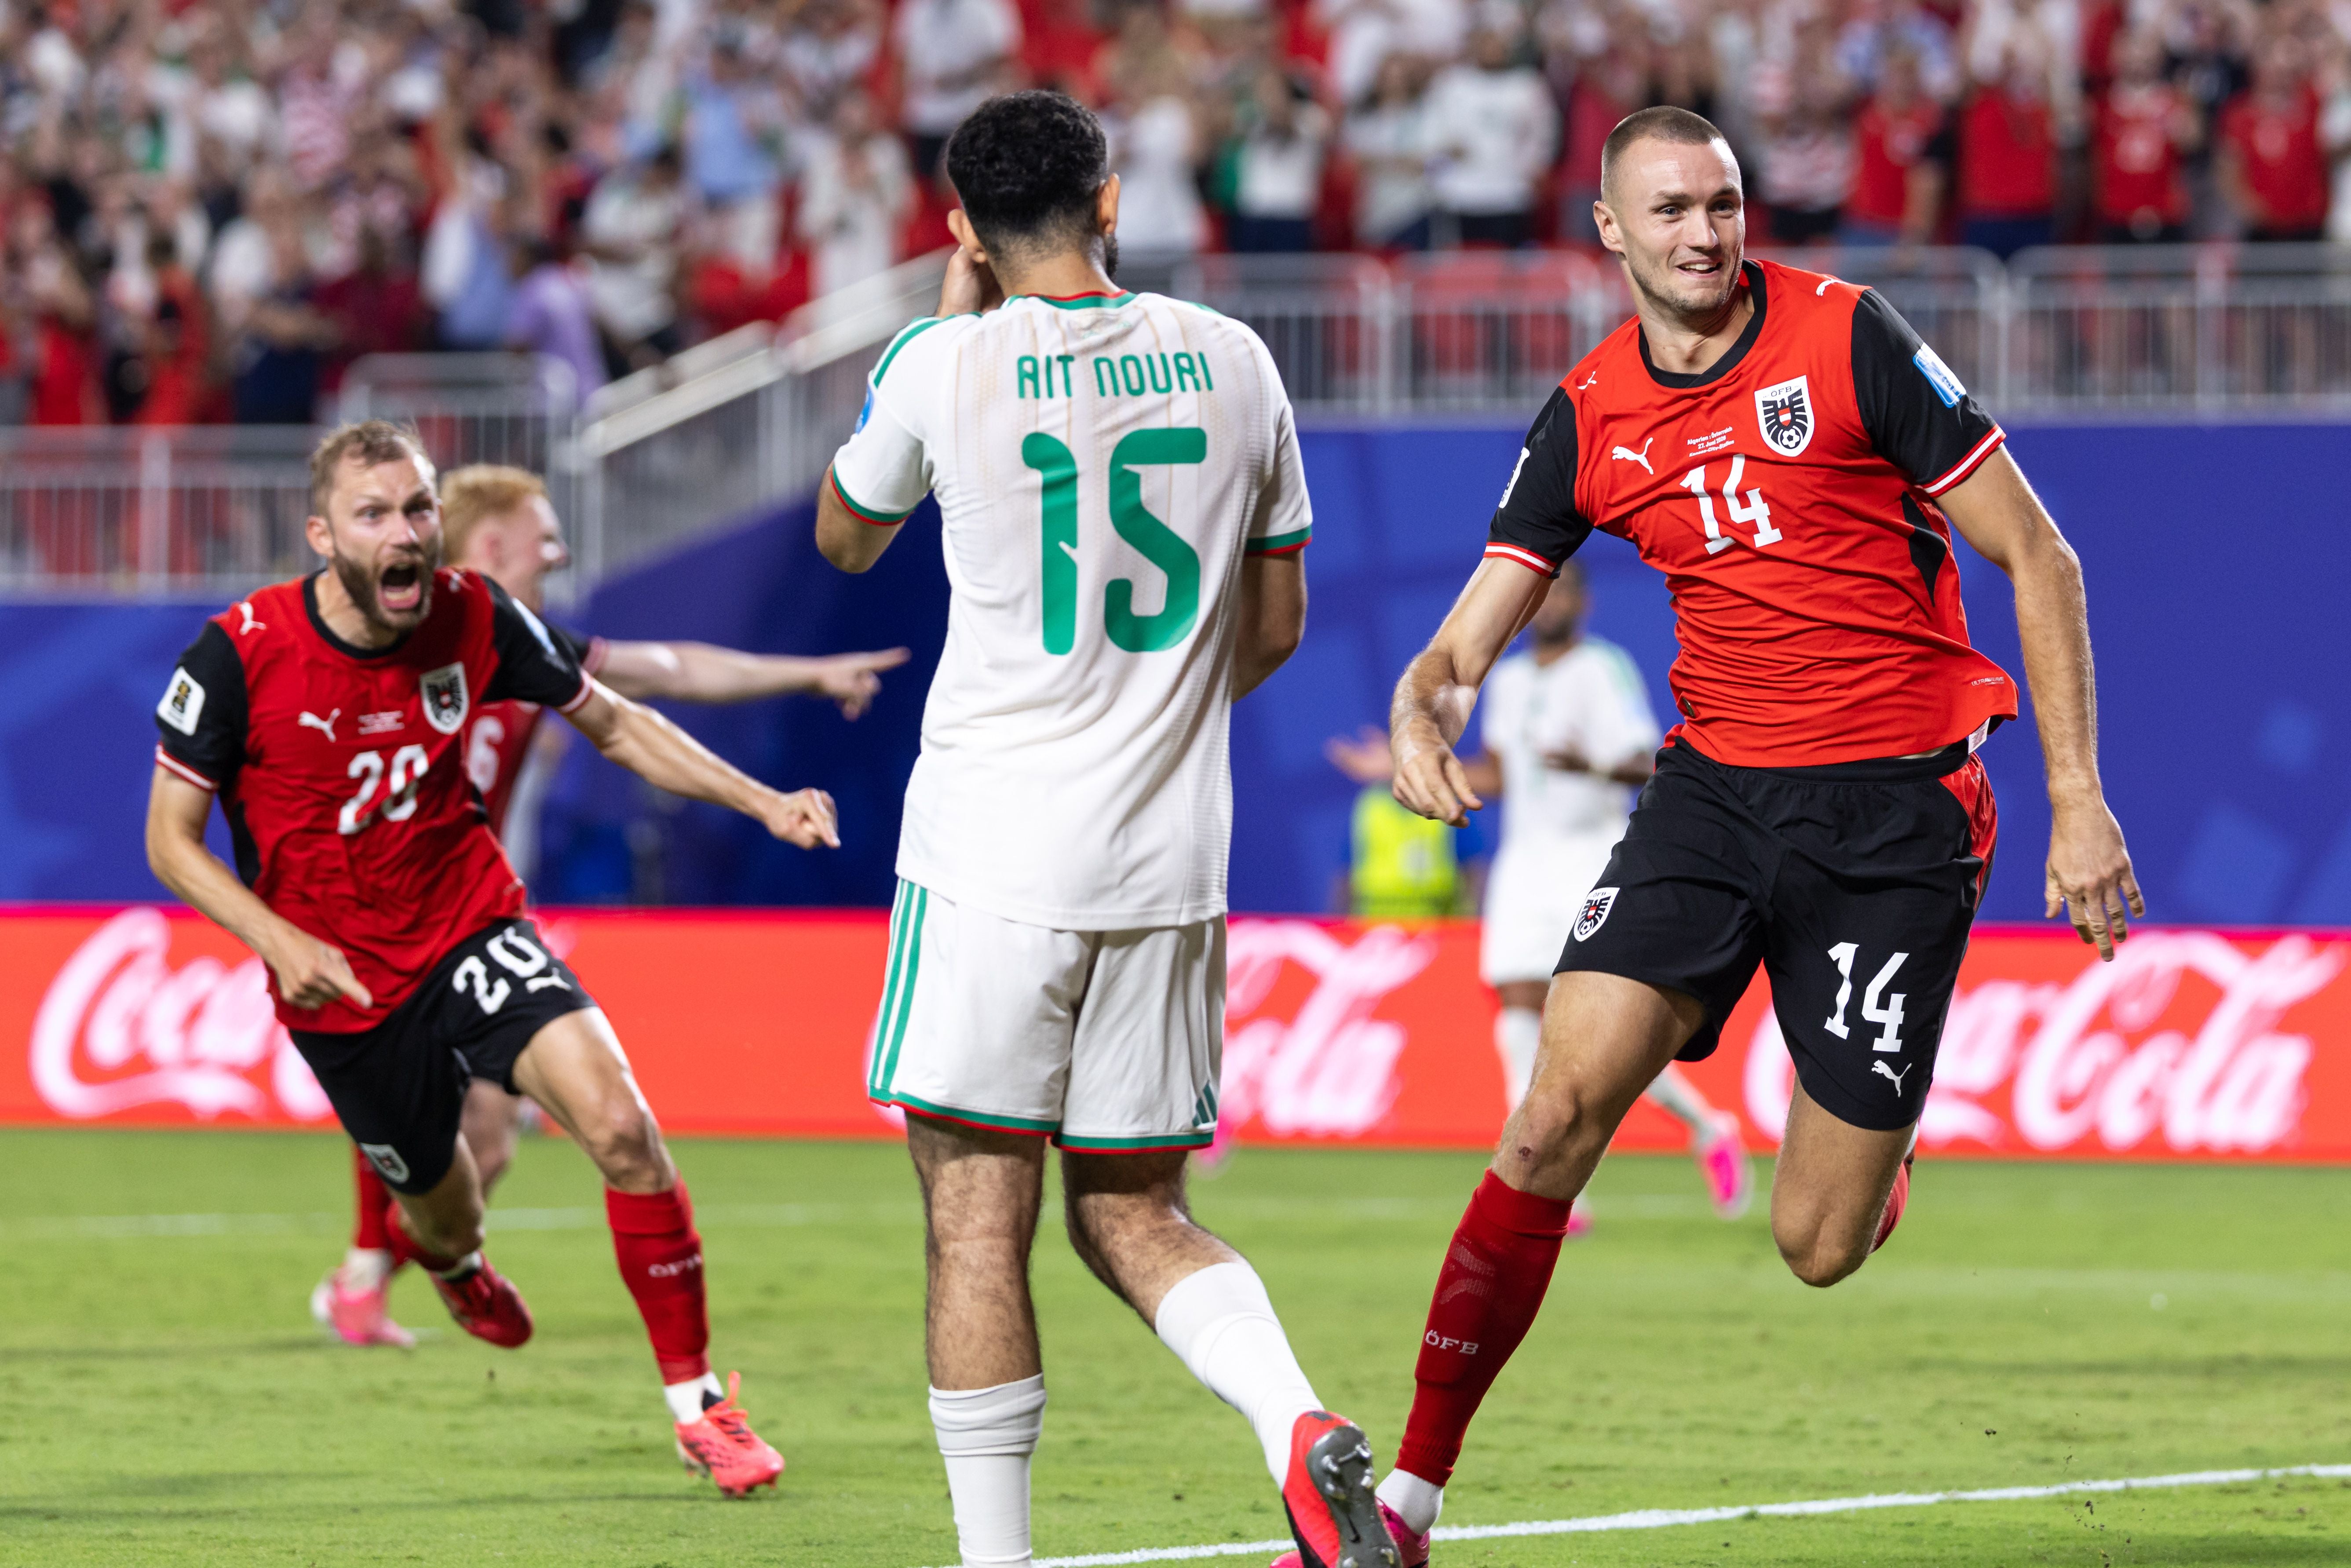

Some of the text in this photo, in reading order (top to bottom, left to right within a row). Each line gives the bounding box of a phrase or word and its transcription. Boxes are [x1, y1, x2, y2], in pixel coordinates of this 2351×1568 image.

[1017, 352, 1213, 398] AIT NOURI
[1687, 436, 1709, 445] Algerien
[1711, 426, 1733, 437] Österreich
[1021, 427, 1207, 655] 15
[1679, 453, 1783, 555] 14
[1971, 676, 2004, 686] ULTRAWEAVE
[337, 743, 430, 835] 20
[452, 926, 550, 1015] 20
[1824, 941, 1909, 1052] 14
[1424, 1329, 1479, 1355] ÖFB
